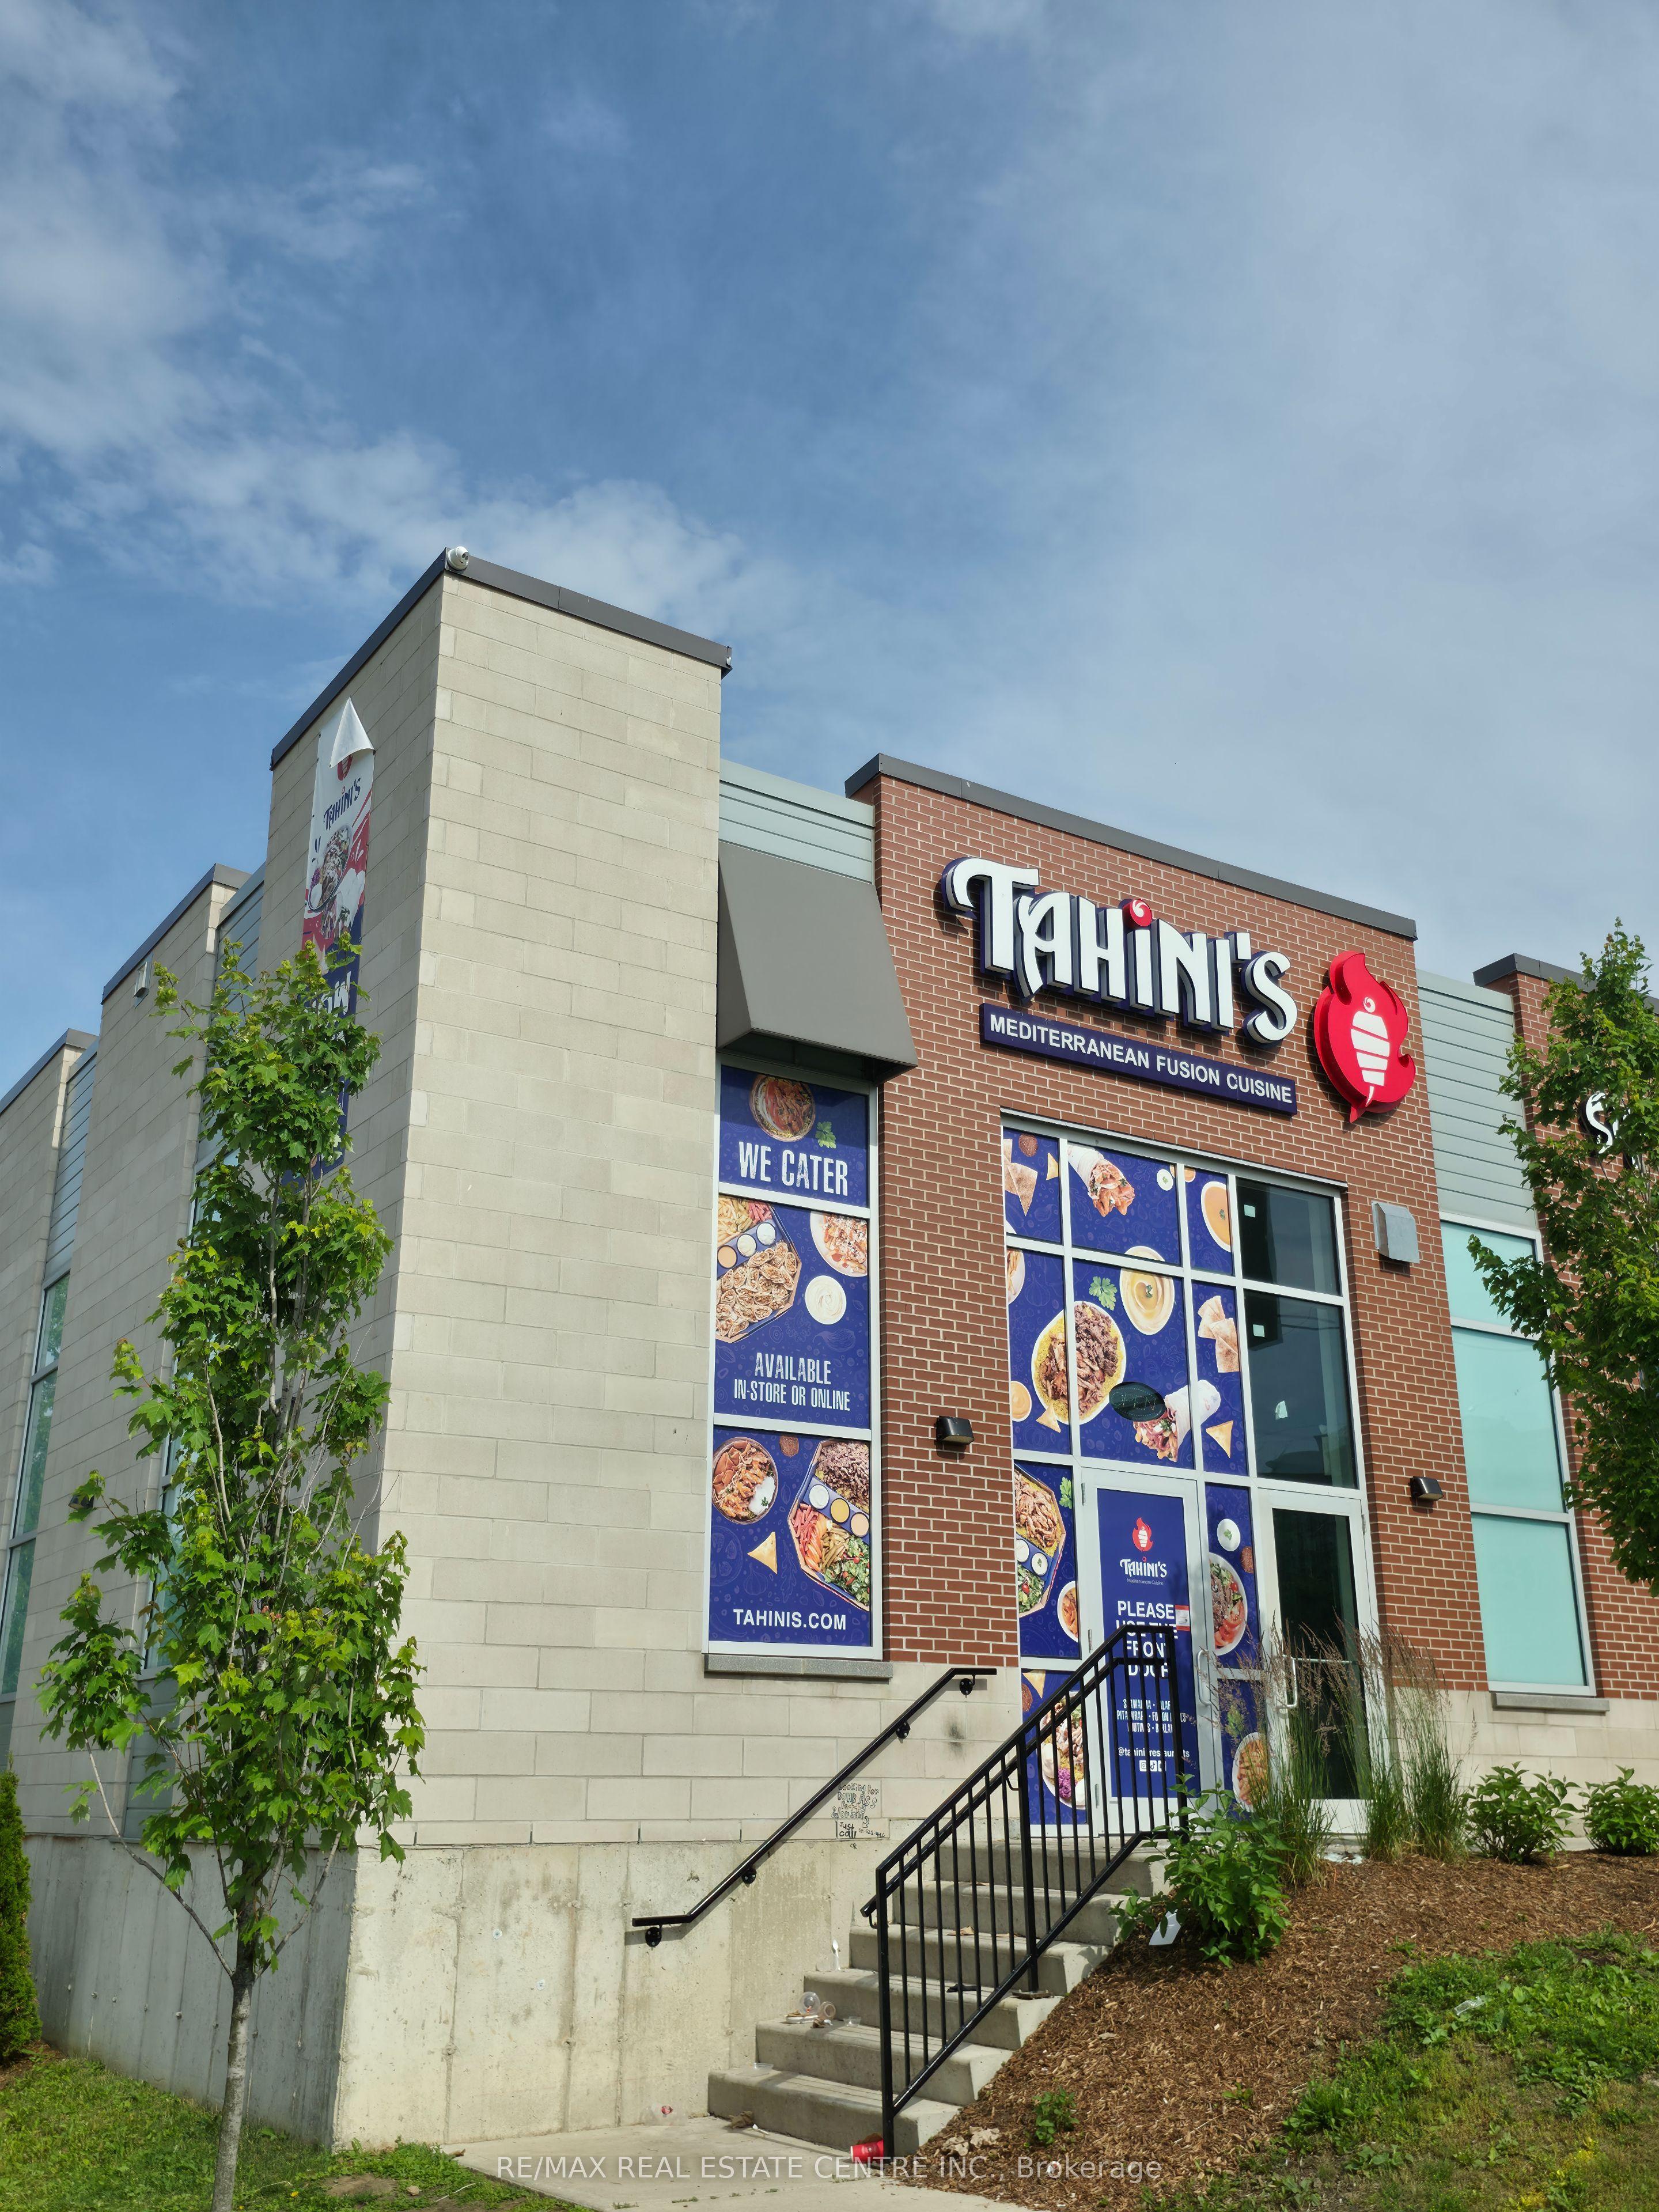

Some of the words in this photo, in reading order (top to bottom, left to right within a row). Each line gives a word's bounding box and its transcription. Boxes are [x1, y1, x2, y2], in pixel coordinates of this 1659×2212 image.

[941, 857, 1298, 1046] TAHINI'S
[990, 1014, 1150, 1069] MEDITERRANEAN
[1156, 1055, 1221, 1087] FUSION
[1226, 1073, 1293, 1104] CUISINE
[738, 1141, 771, 1183] WE
[782, 1149, 849, 1196] CATER
[755, 1352, 831, 1385] AVAILABLE
[734, 1378, 787, 1404] IN-STORE
[791, 1385, 806, 1406] OR
[810, 1388, 850, 1411] ONLINE
[1120, 1556, 1167, 1578] TAHINI'S
[733, 1608, 846, 1630] TAHINIS.COM
[1118, 1600, 1175, 1619] PLEASE
[1117, 1710, 1128, 1720] PITA
